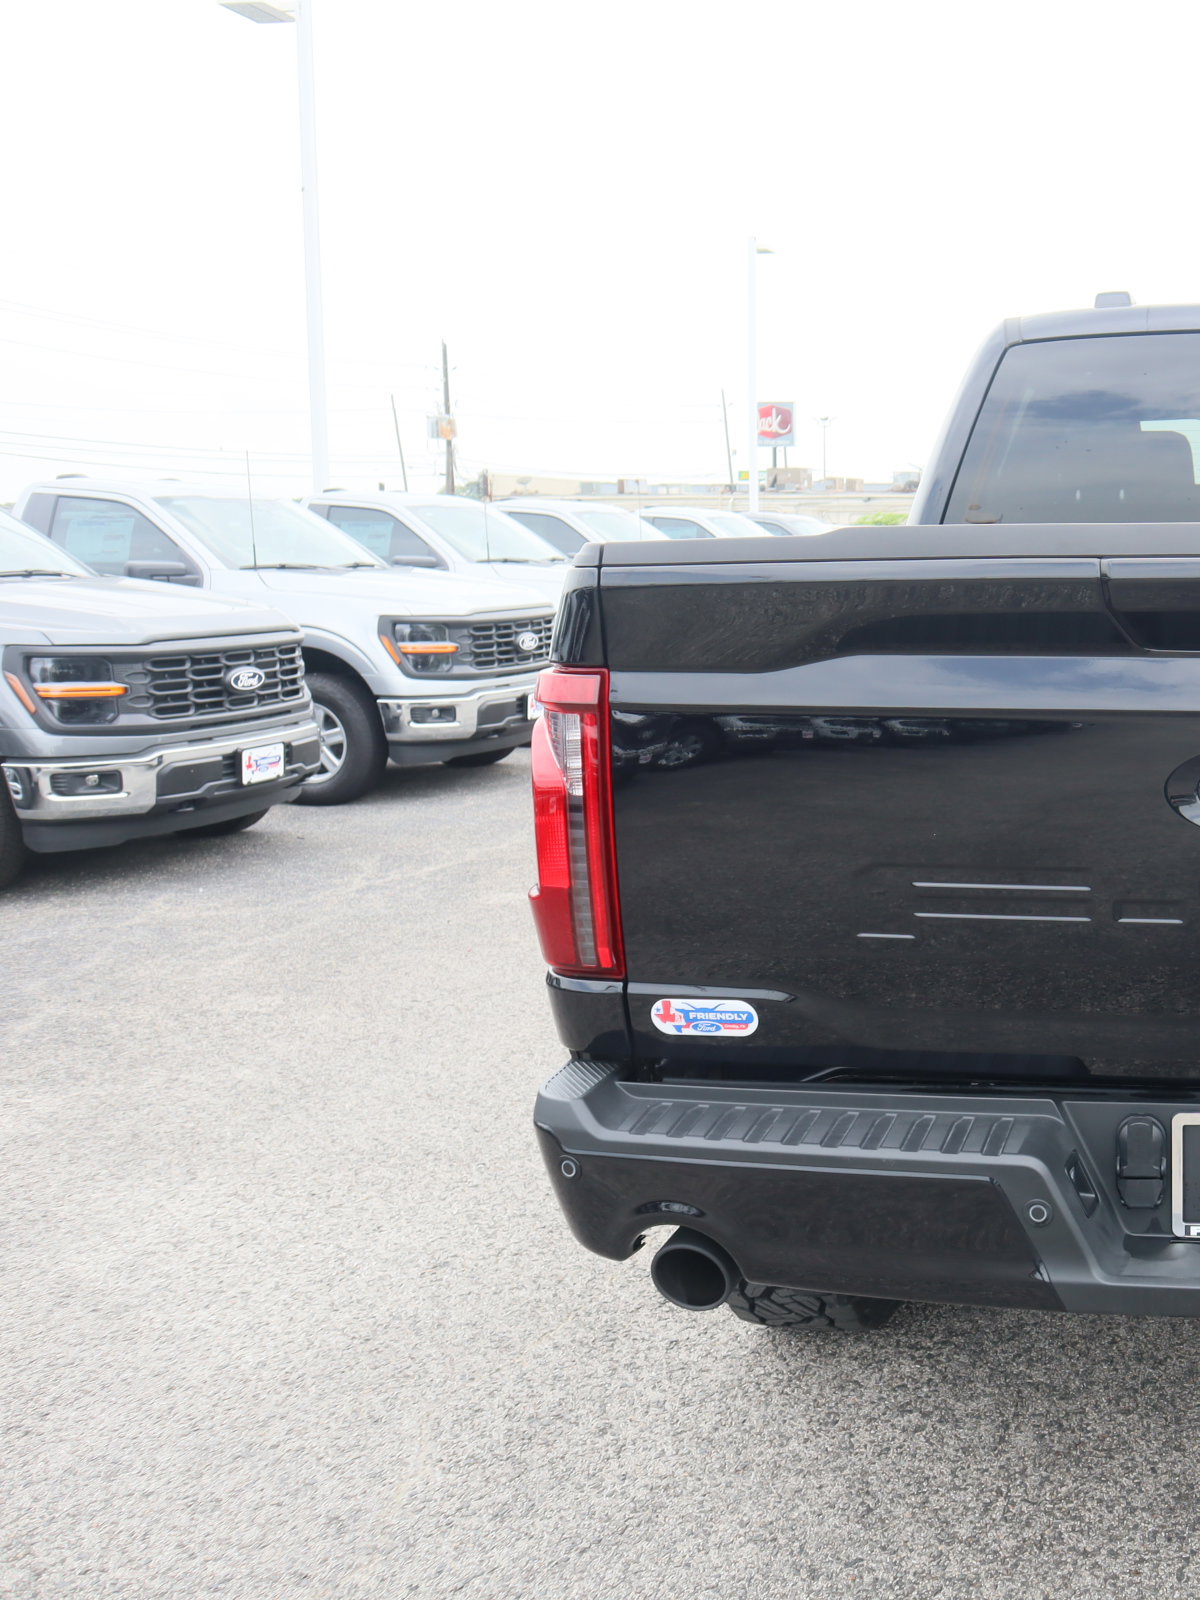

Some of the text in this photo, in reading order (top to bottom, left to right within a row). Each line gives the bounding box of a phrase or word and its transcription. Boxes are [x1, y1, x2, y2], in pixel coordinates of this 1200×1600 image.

[757, 408, 790, 434] ack
[238, 672, 259, 687] Ford
[689, 1012, 748, 1021] FRIENDLY
[697, 1023, 717, 1032] Ford
